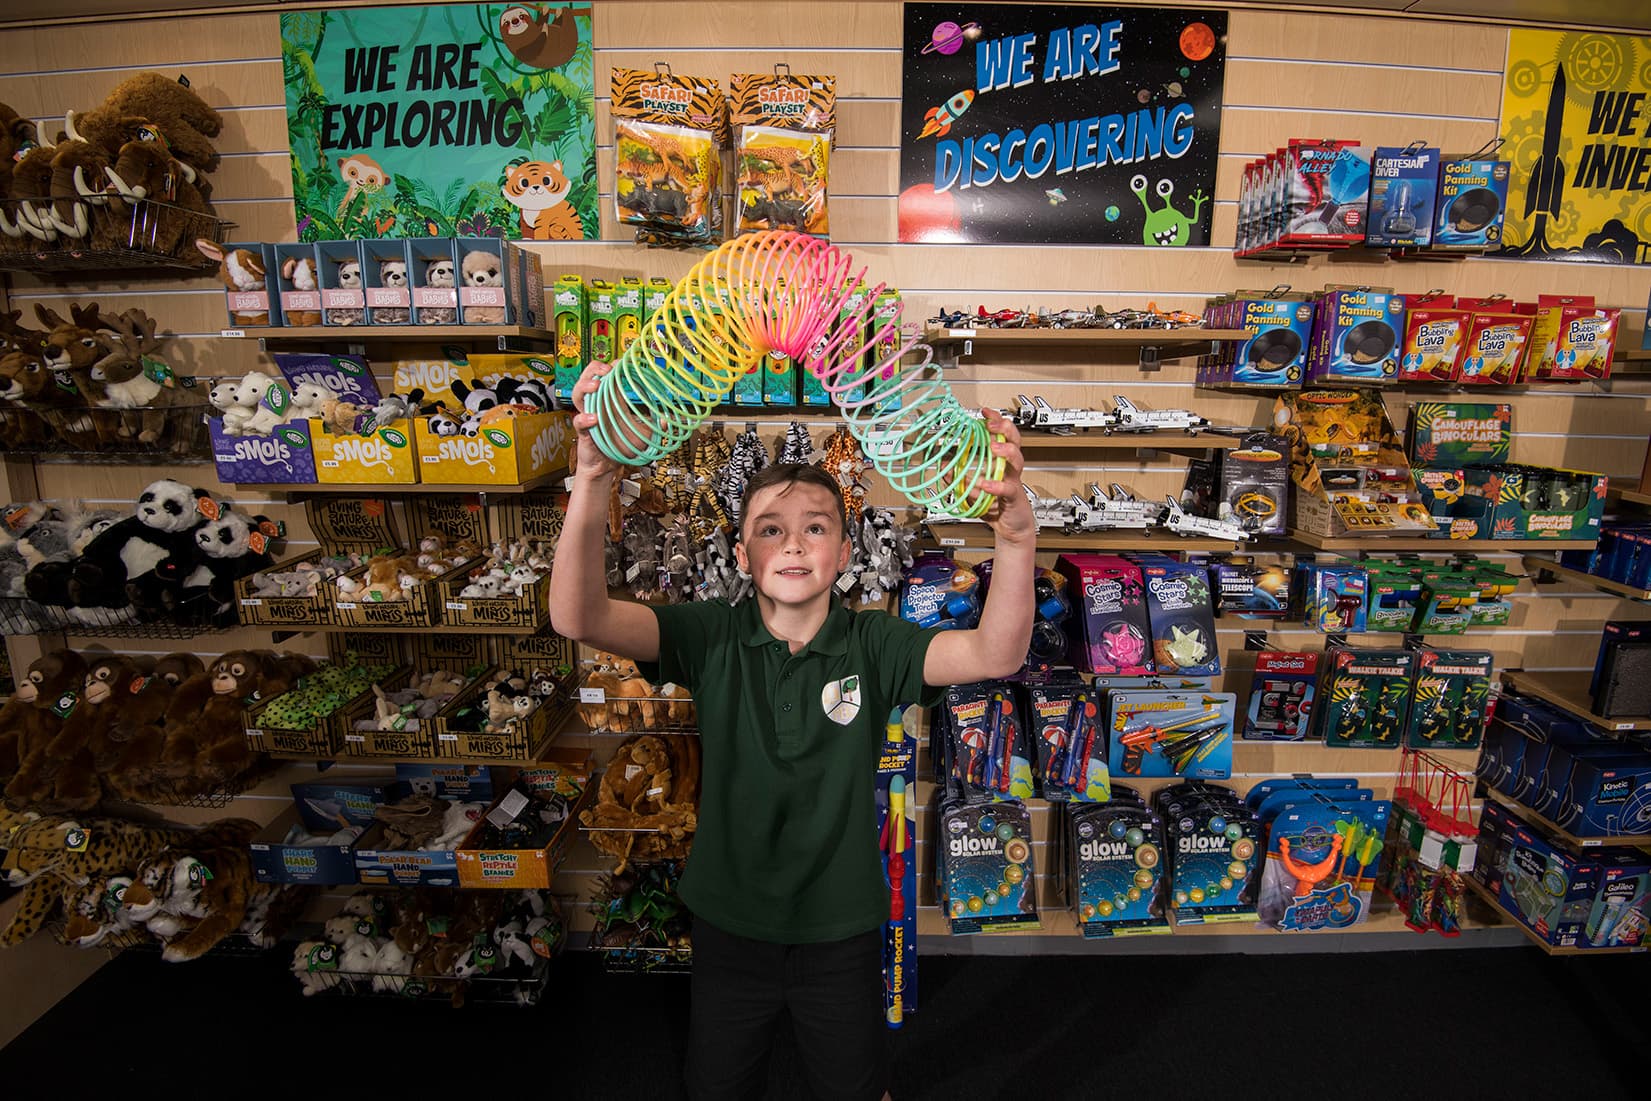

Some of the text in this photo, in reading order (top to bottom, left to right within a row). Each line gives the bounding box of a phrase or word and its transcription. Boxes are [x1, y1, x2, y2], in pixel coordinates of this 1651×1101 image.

[976, 20, 1122, 93] WE ARE
[344, 42, 482, 94] WE ARE
[640, 83, 692, 102] SAFARI
[759, 87, 810, 103] SAFARI
[644, 100, 688, 113] PLAYSET
[762, 103, 805, 114] PLAYSET
[1588, 90, 1646, 136] WE
[320, 97, 524, 150] EXPLORING
[934, 102, 1194, 194] DISCOVERING
[1300, 150, 1352, 160] TRNADO
[1299, 163, 1336, 174] ALLEY
[1376, 159, 1424, 169] CARTESIAN
[1446, 164, 1471, 173] Gold
[1572, 144, 1651, 192] INVE
[1375, 168, 1399, 176] DIVER
[1445, 175, 1488, 186] Panning
[1443, 186, 1458, 195] Kit
[1341, 294, 1366, 304] Gold
[1248, 303, 1274, 313] Gold
[1340, 305, 1383, 318] Panning
[1246, 314, 1290, 326] Panning
[1338, 316, 1353, 326] Kit
[1421, 325, 1454, 337] Bubbling
[1482, 330, 1515, 341] Bubbling
[1417, 336, 1445, 346] Lava
[1569, 332, 1595, 343] Lava
[1478, 340, 1505, 351] Lava
[1039, 413, 1049, 423] US
[1123, 415, 1131, 423] US
[1432, 417, 1501, 430] CAMOUFLAGE
[1432, 431, 1501, 444] BINOCULARS
[1097, 502, 1105, 510] US
[1078, 513, 1087, 521] US
[1170, 514, 1180, 524] US
[910, 585, 935, 596] Space
[1086, 582, 1121, 597] Cosmic
[1150, 579, 1187, 593] Cosmic
[908, 592, 945, 606] Projector
[1095, 590, 1121, 605] Stars
[1158, 589, 1185, 602] Stars
[914, 602, 937, 612] Torch
[1349, 666, 1405, 676] WALKIE TALKIE
[1433, 666, 1486, 675] WALKIE TALKIE
[951, 700, 988, 714] PARACHUTE
[1035, 699, 1071, 711] PARACHUTE
[1117, 701, 1186, 712] JET LAUNCHER
[958, 707, 986, 720] ROCKET
[1040, 707, 1068, 717] ROCKET
[1604, 781, 1629, 791] Kinetic
[950, 836, 997, 856] glow
[1179, 833, 1226, 853] glow
[1080, 840, 1127, 861] glow
[285, 857, 317, 866] HAND
[1608, 881, 1634, 891] Galileo
[895, 927, 904, 963] ROCKET
[894, 965, 903, 993] PUMP
